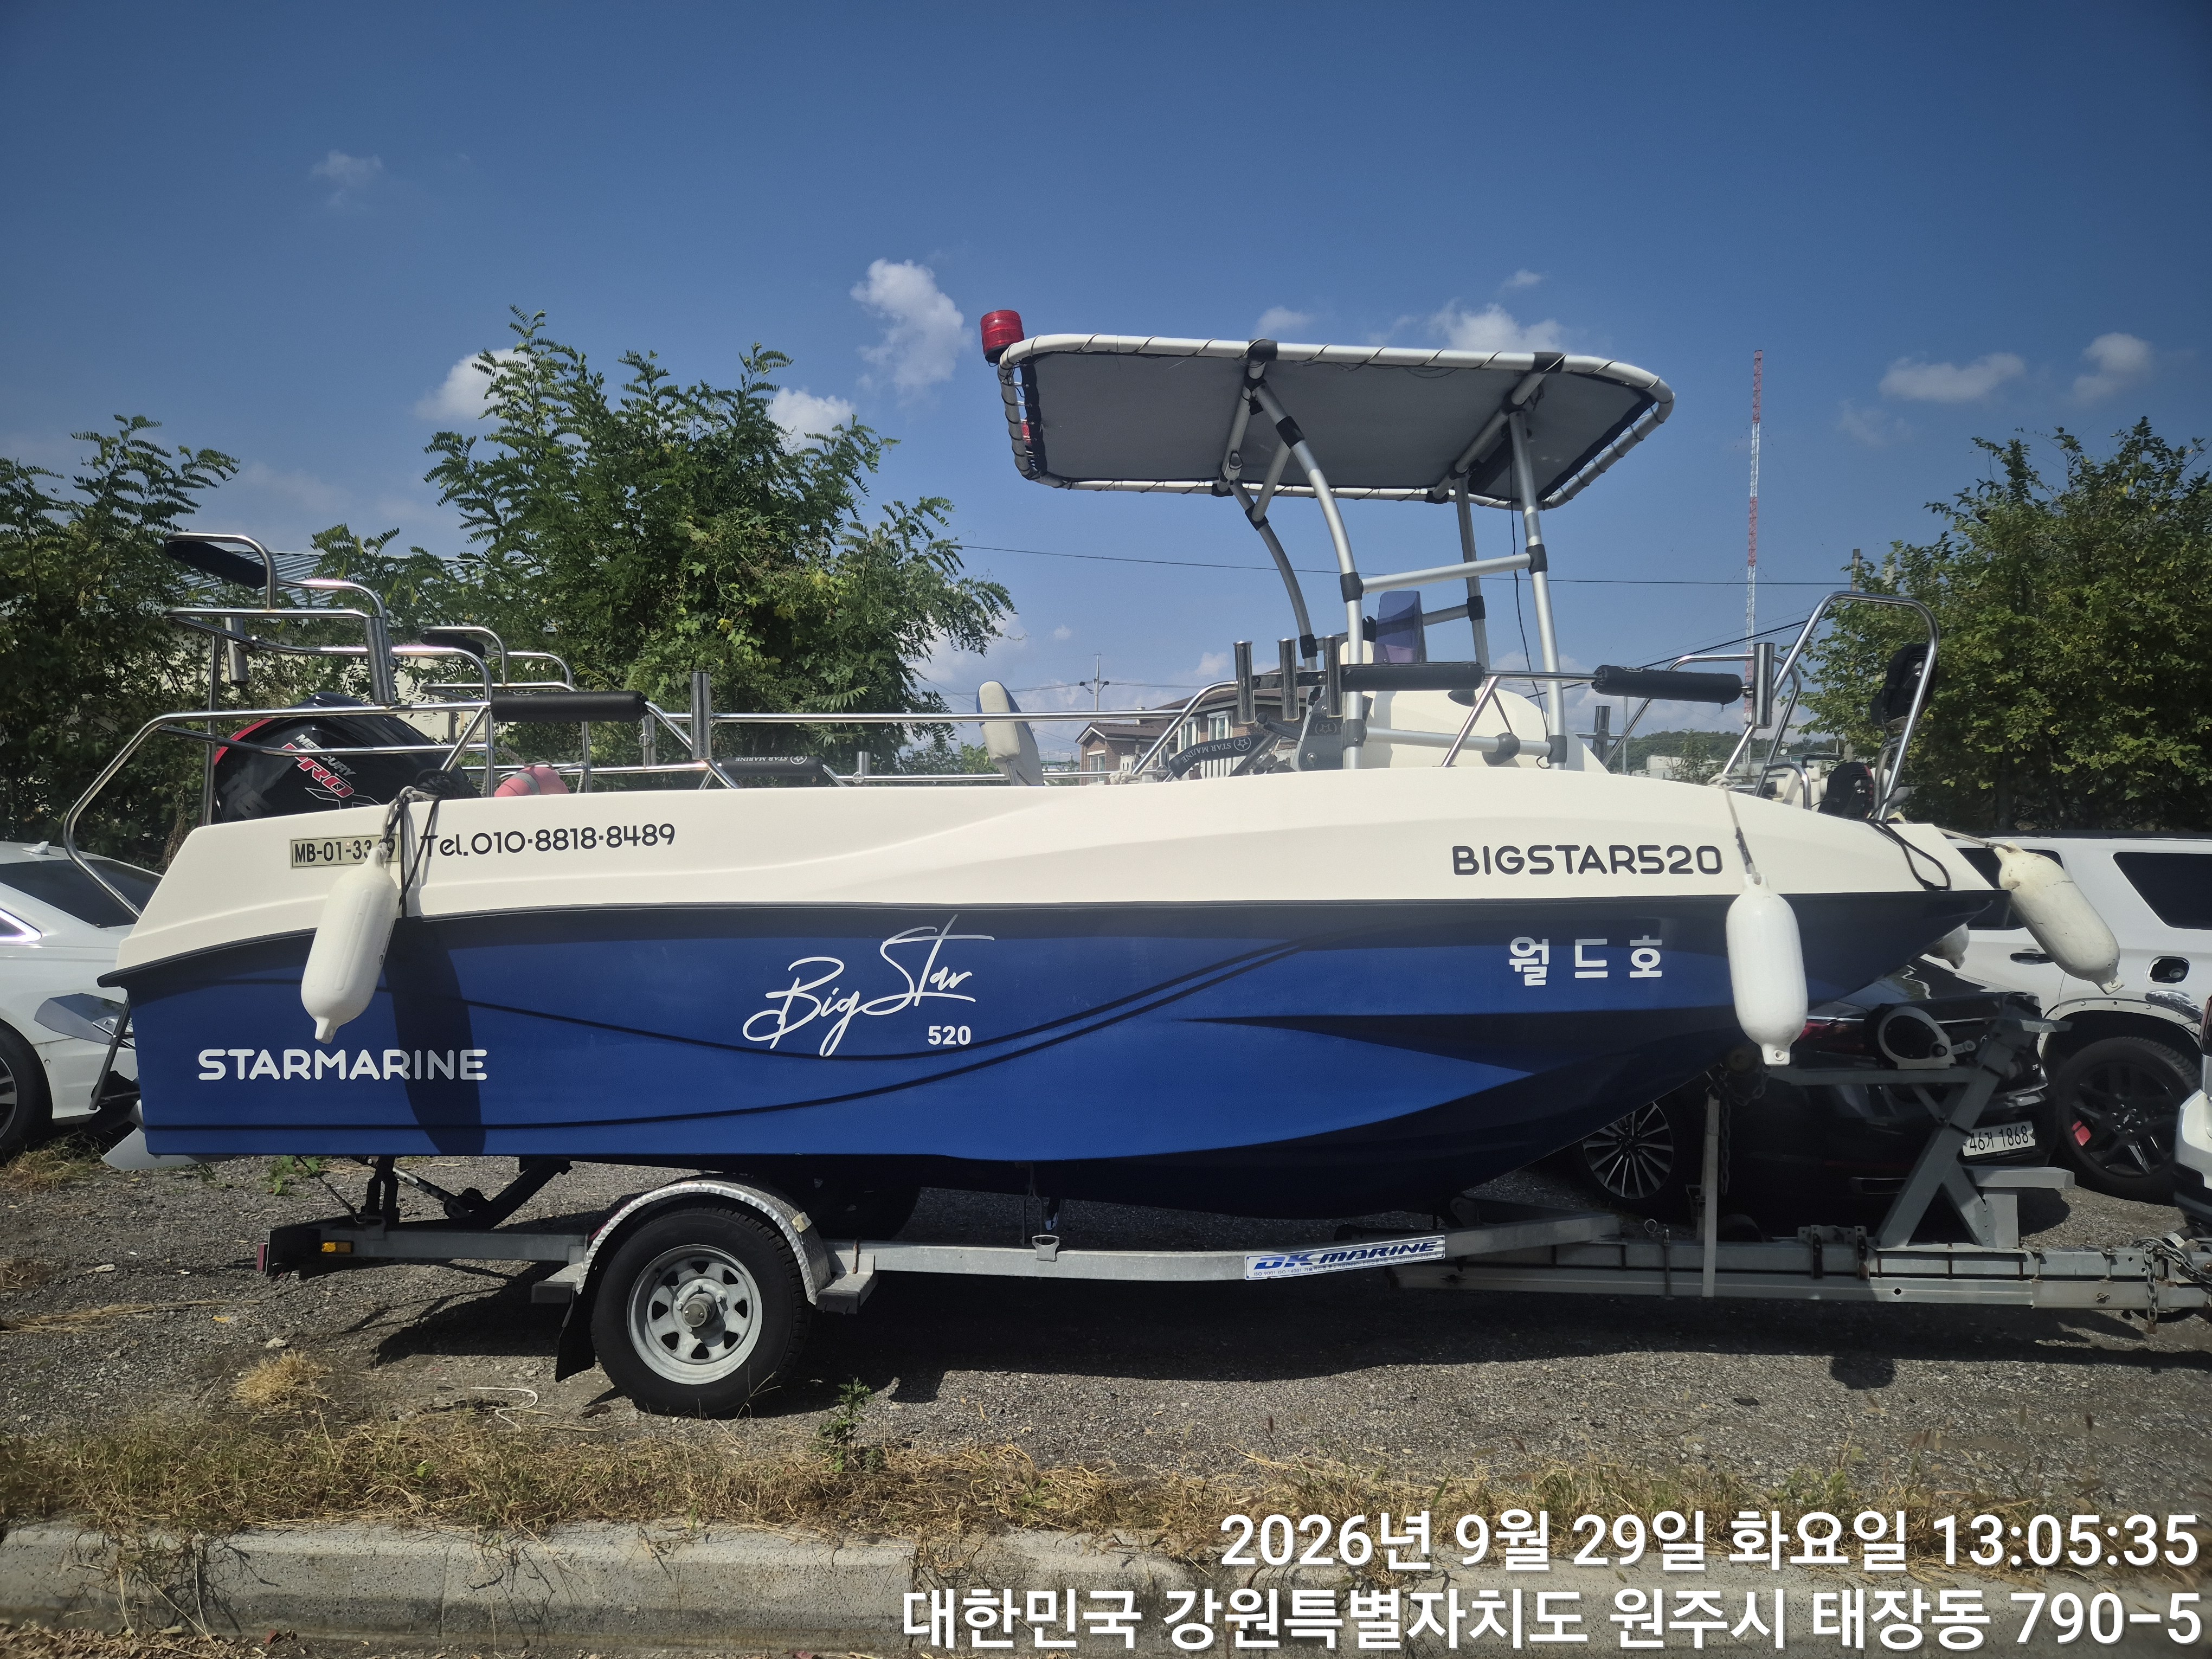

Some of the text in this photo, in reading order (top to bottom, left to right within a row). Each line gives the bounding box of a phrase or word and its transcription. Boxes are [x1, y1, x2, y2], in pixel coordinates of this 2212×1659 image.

[1211, 742, 1232, 751] STAR
[294, 838, 396, 863] MB-01-339
[1452, 845, 1722, 875] BIGSTAR520
[742, 914, 995, 1057] Big Star
[928, 1025, 972, 1045] 520
[198, 1049, 488, 1081] STARMARINE
[1998, 1125, 2029, 1148] 1868
[1253, 1241, 1438, 1270] DK MARINE
